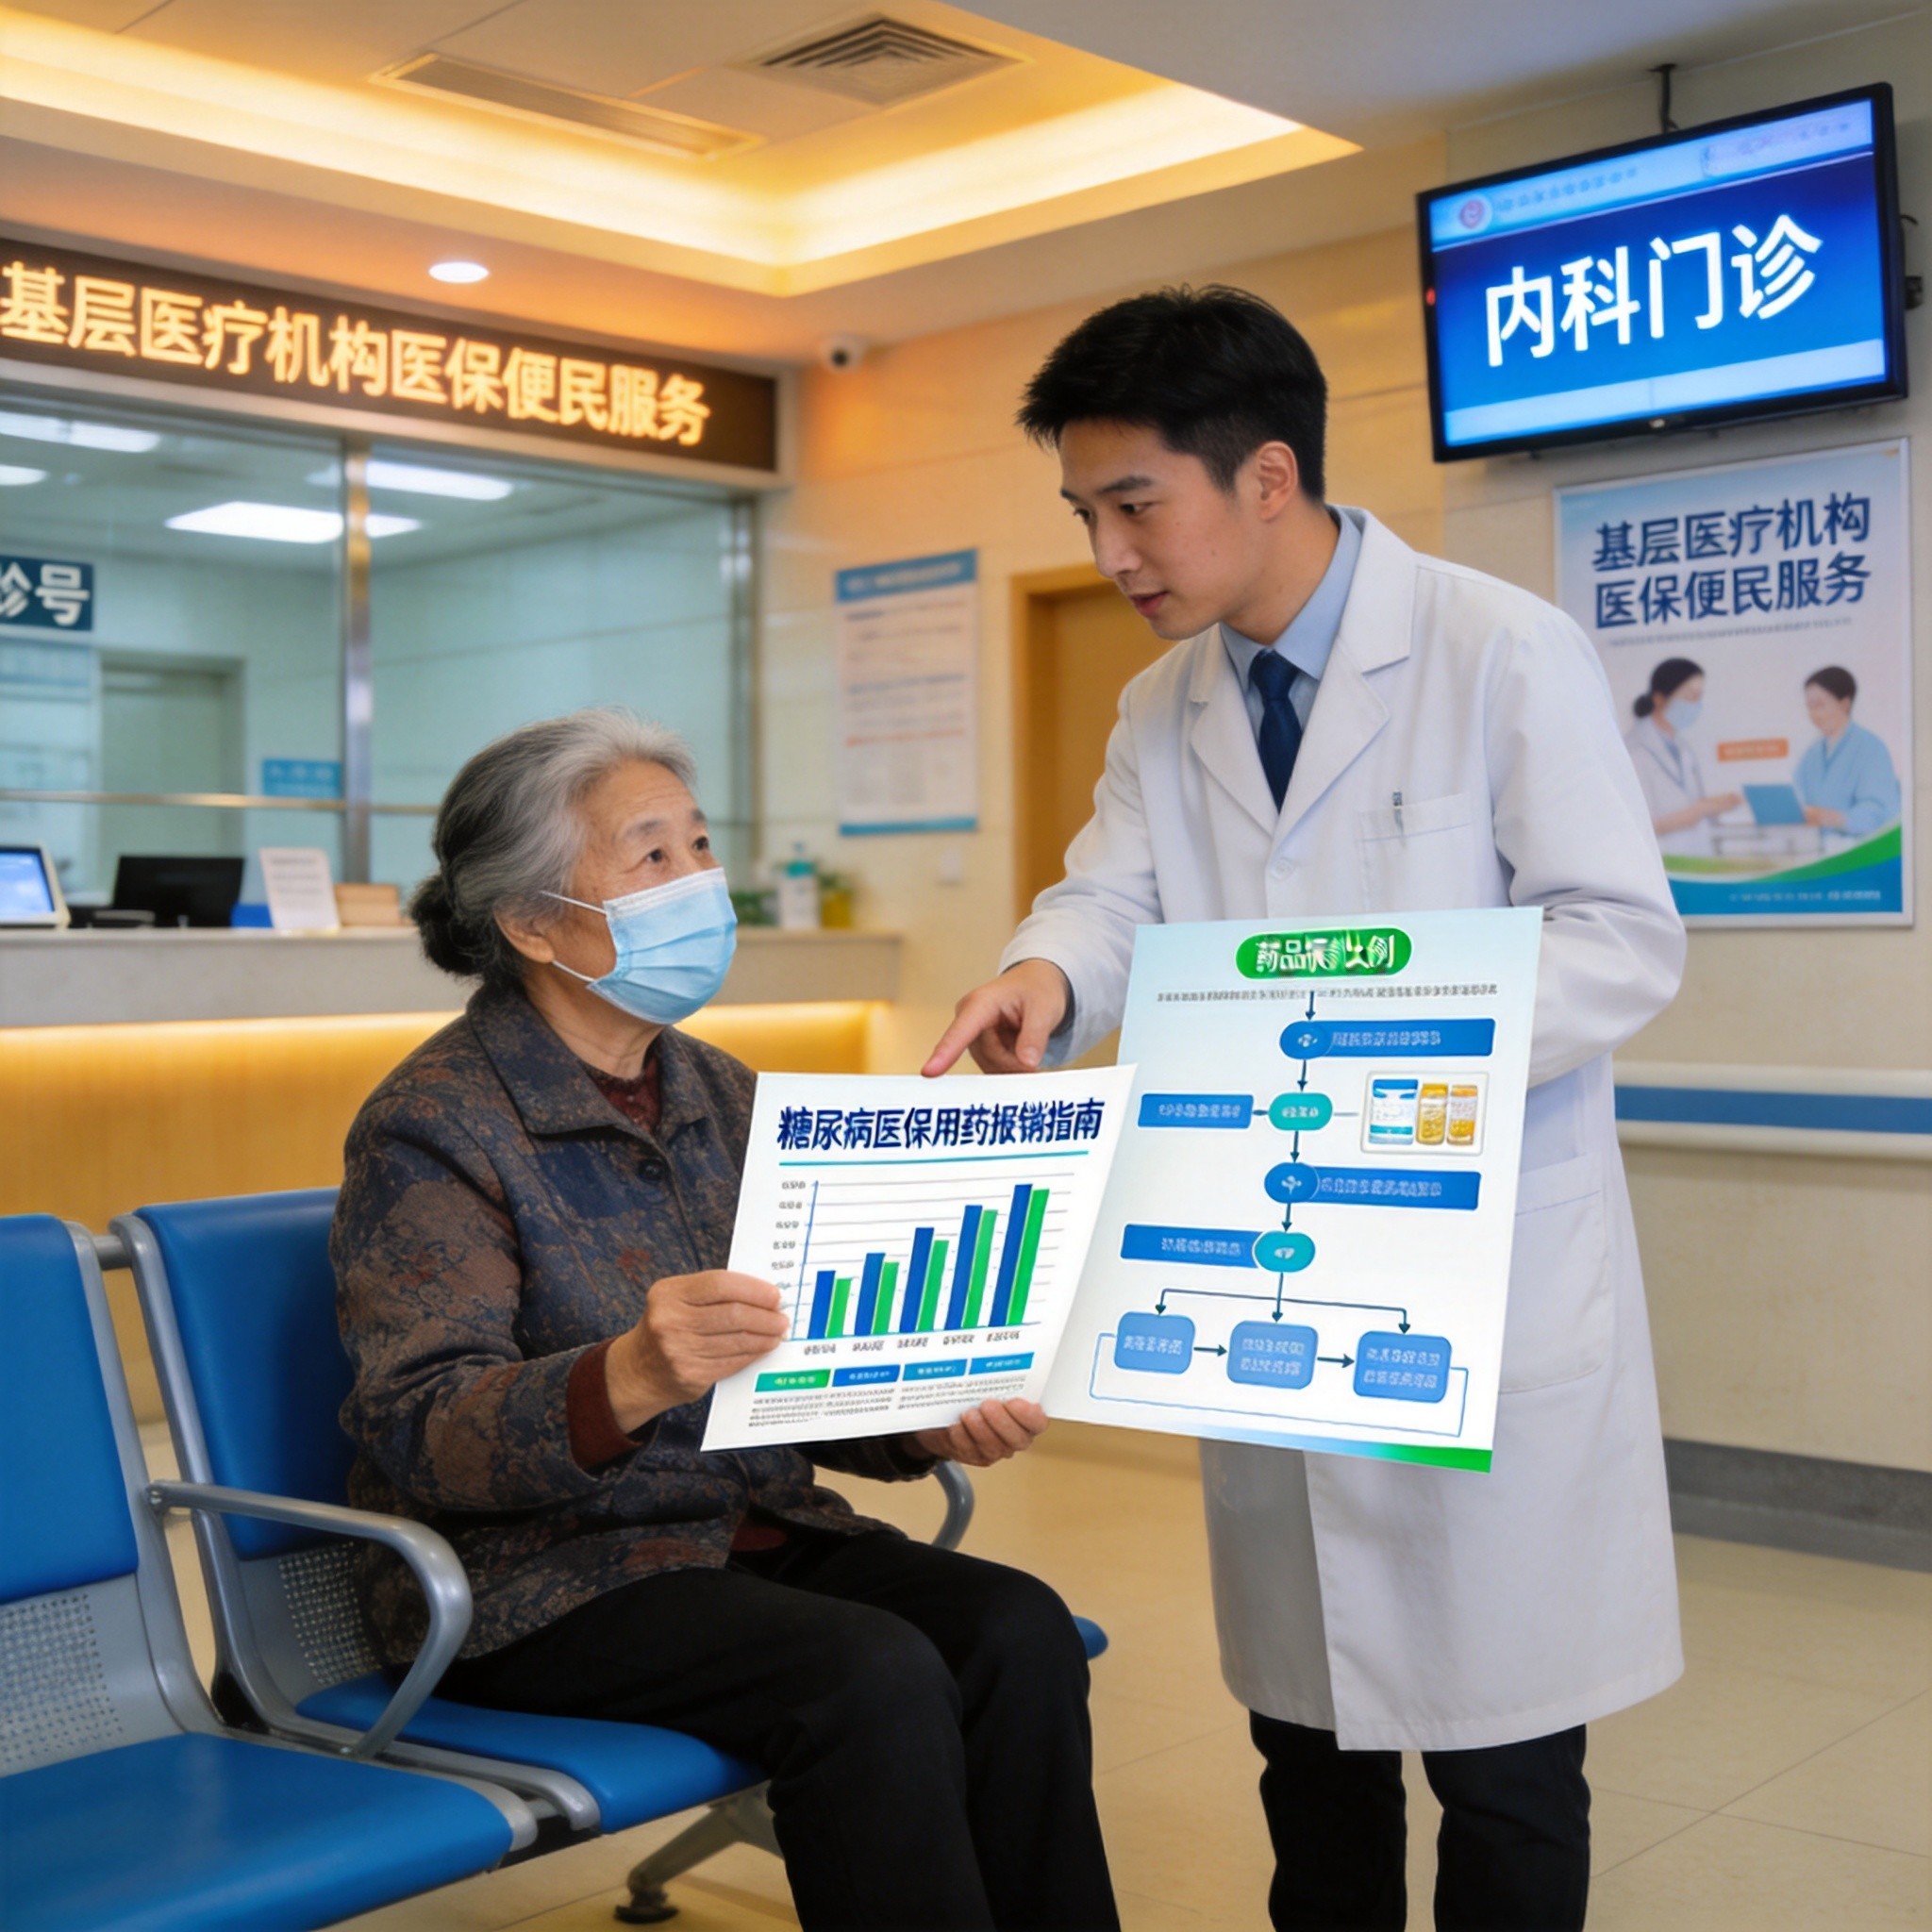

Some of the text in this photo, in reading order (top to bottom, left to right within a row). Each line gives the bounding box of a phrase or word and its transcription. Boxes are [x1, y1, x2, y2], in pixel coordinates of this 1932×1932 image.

[1485, 214, 1823, 367] 内科门诊
[1, 260, 711, 446] 基层医疗机构医保便民服务
[1591, 491, 1872, 573] 基层医疗机构
[1594, 550, 1872, 629] 医保便民服务
[776, 1097, 1105, 1151] 糖尿病医保用药报销指南
